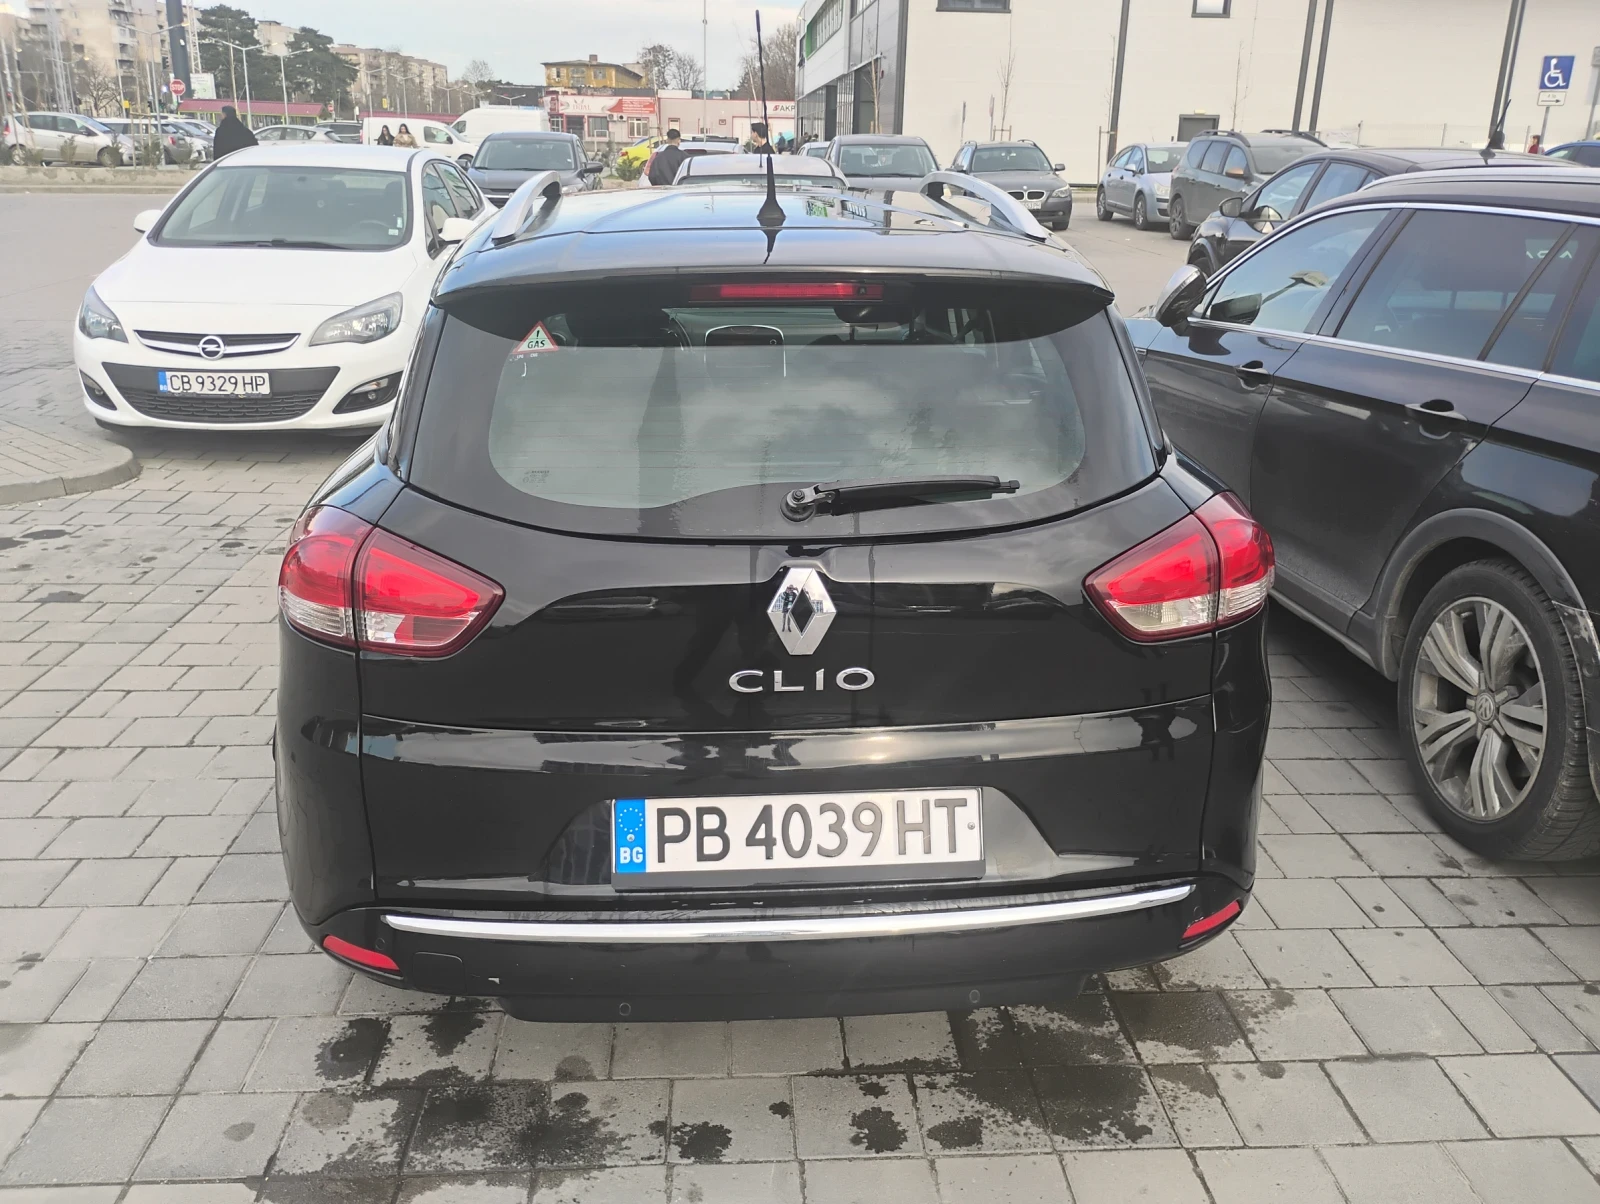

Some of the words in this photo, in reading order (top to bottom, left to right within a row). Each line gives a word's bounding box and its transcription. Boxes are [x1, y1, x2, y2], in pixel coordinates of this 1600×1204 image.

[528, 340, 545, 348] GAS
[169, 374, 192, 392] CB
[195, 375, 238, 392] 9329
[242, 375, 266, 392] HP
[728, 667, 875, 693] CLIO
[656, 805, 731, 863] PB
[745, 801, 883, 860] 4039
[896, 797, 968, 856] HT
[619, 846, 644, 864] BG
